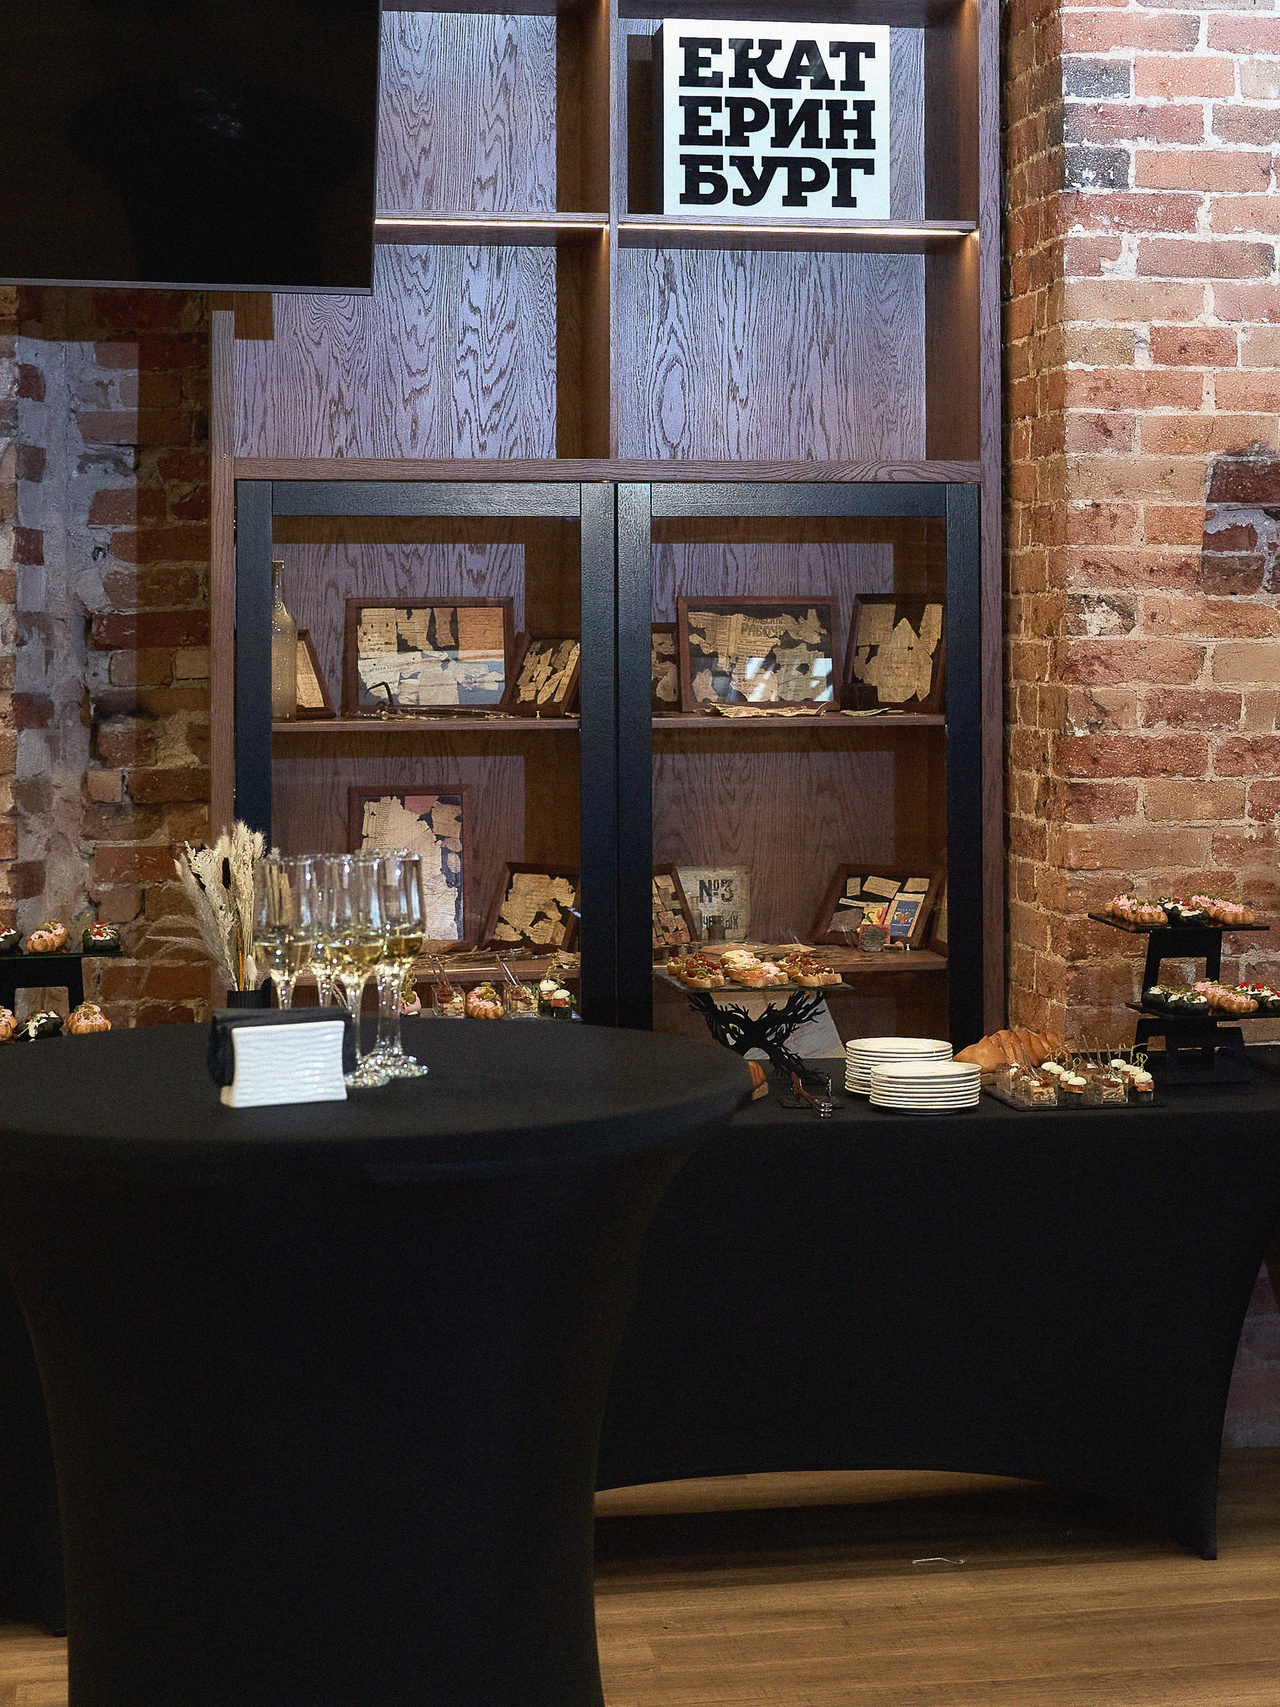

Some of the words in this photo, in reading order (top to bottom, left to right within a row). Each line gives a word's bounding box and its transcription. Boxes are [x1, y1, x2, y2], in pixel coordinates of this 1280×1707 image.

[679, 37, 876, 92] ЕКАТ
[679, 95, 876, 150] ЕРИН
[679, 153, 876, 208] БУРГ
